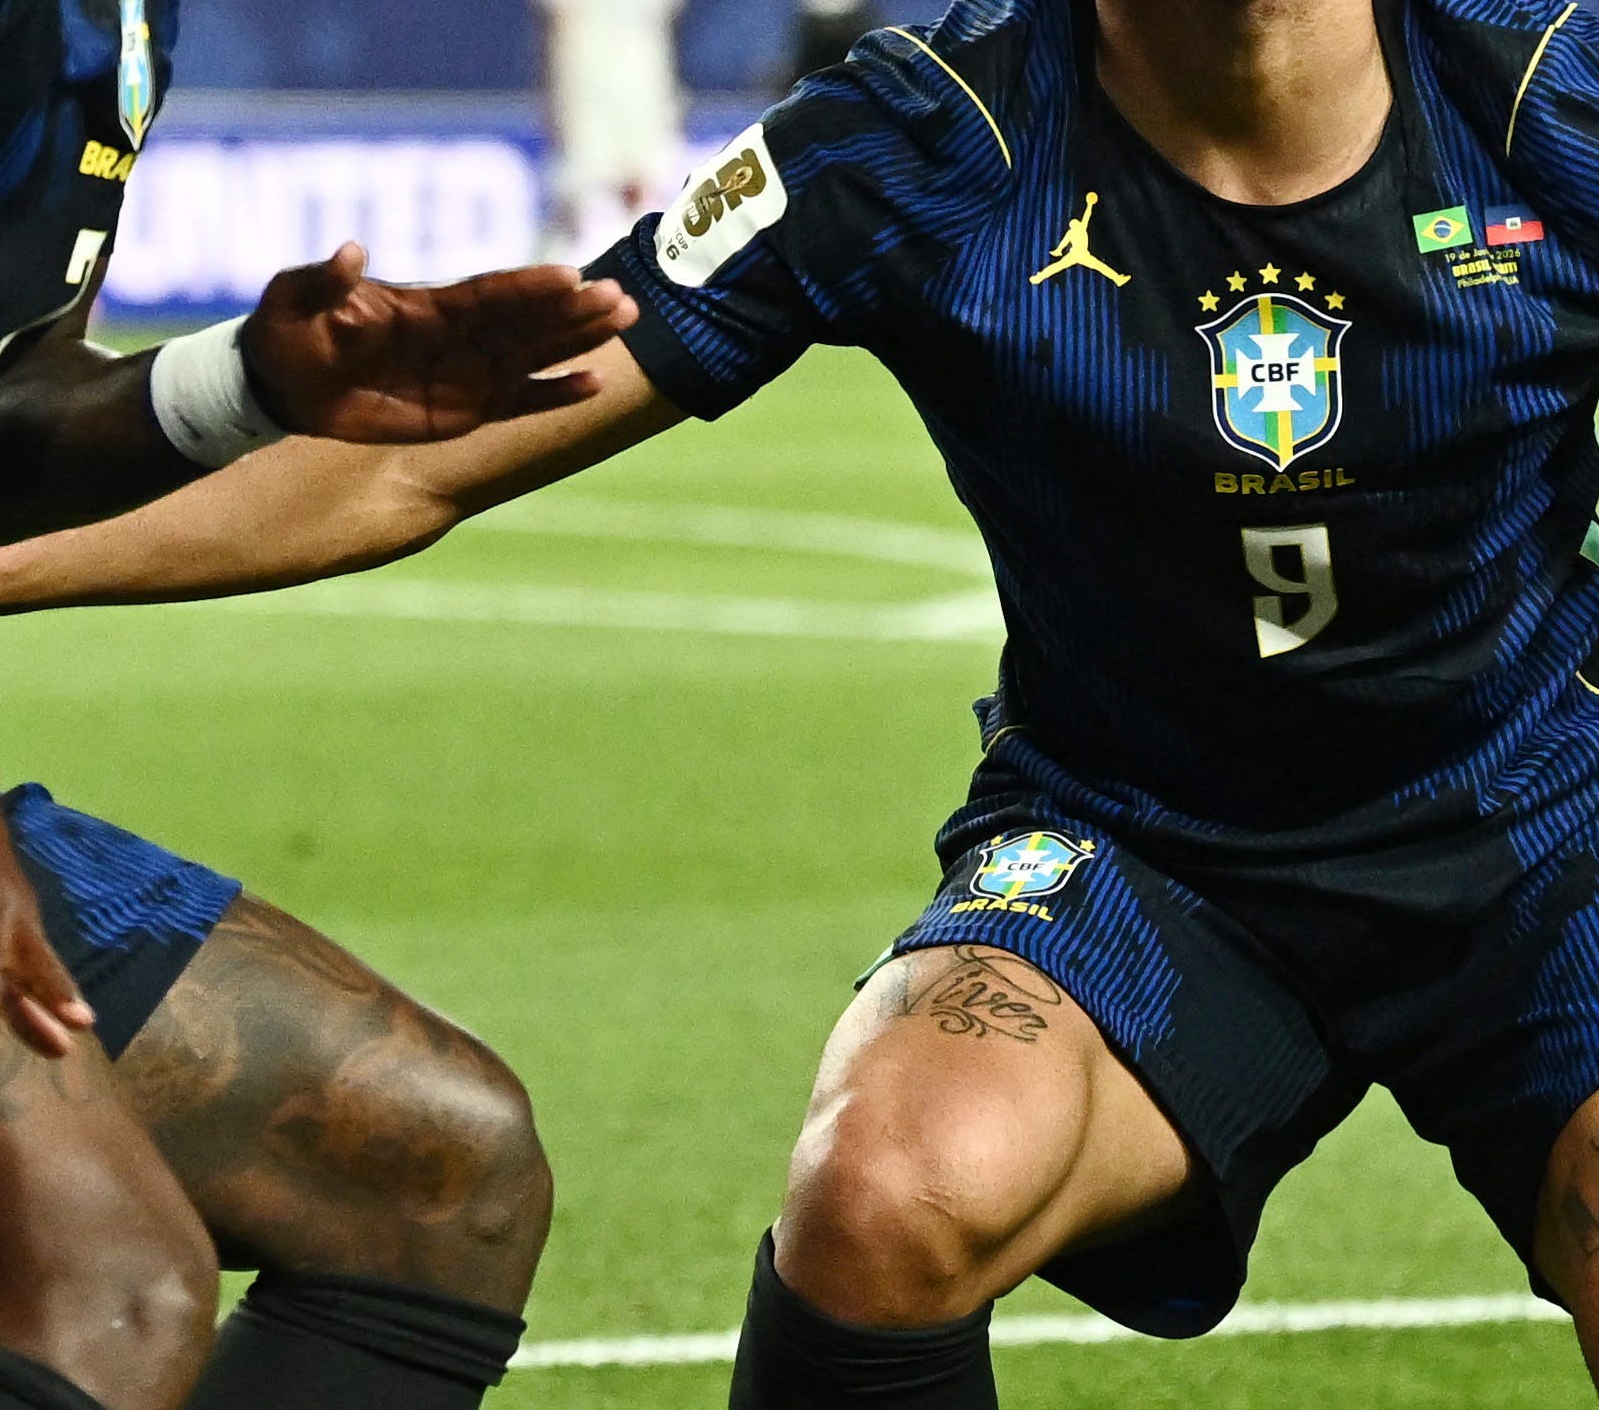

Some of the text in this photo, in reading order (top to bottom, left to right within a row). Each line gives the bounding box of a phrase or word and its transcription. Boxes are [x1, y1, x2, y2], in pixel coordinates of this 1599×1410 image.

[78, 139, 139, 183] BRA
[675, 232, 689, 251] CUP
[1445, 251, 1457, 263] 19
[1459, 249, 1472, 260] de
[1496, 247, 1521, 260] 2026
[1452, 259, 1492, 277] BRASIL
[1250, 362, 1301, 383] CBF
[1214, 467, 1357, 495] BRASIL
[1240, 522, 1339, 659] 9
[1006, 861, 1046, 872] CBF
[949, 898, 1054, 922] BRASIL
